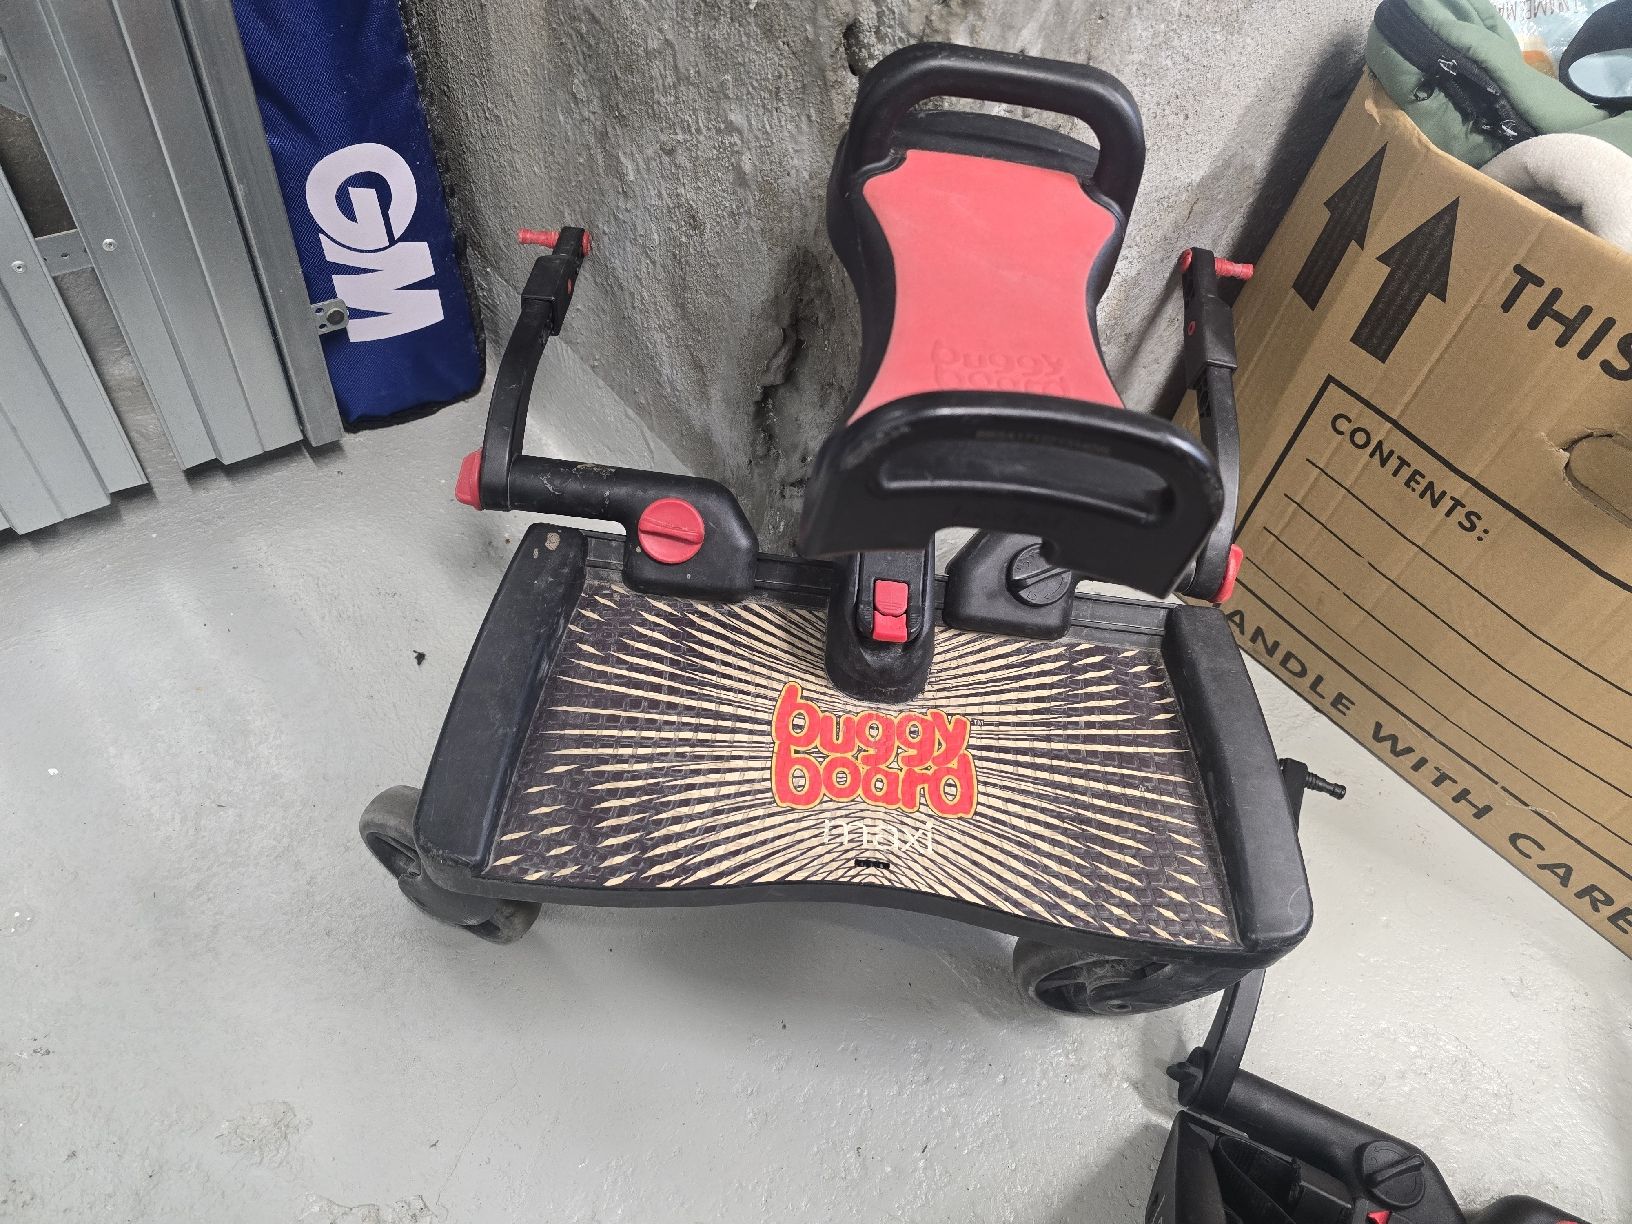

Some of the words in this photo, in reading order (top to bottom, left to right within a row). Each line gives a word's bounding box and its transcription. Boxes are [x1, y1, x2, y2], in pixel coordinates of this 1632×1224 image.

[306, 142, 444, 342] GM
[931, 339, 1065, 376] buggy
[1501, 264, 1632, 381] THIS
[1331, 413, 1489, 541] CONTENTS:
[772, 681, 971, 767] buggy
[1212, 603, 1356, 716] ANDLE
[1371, 721, 1494, 820] WITH
[1508, 832, 1632, 935] CARE
[770, 742, 978, 818] board
[823, 819, 934, 854] maxi
